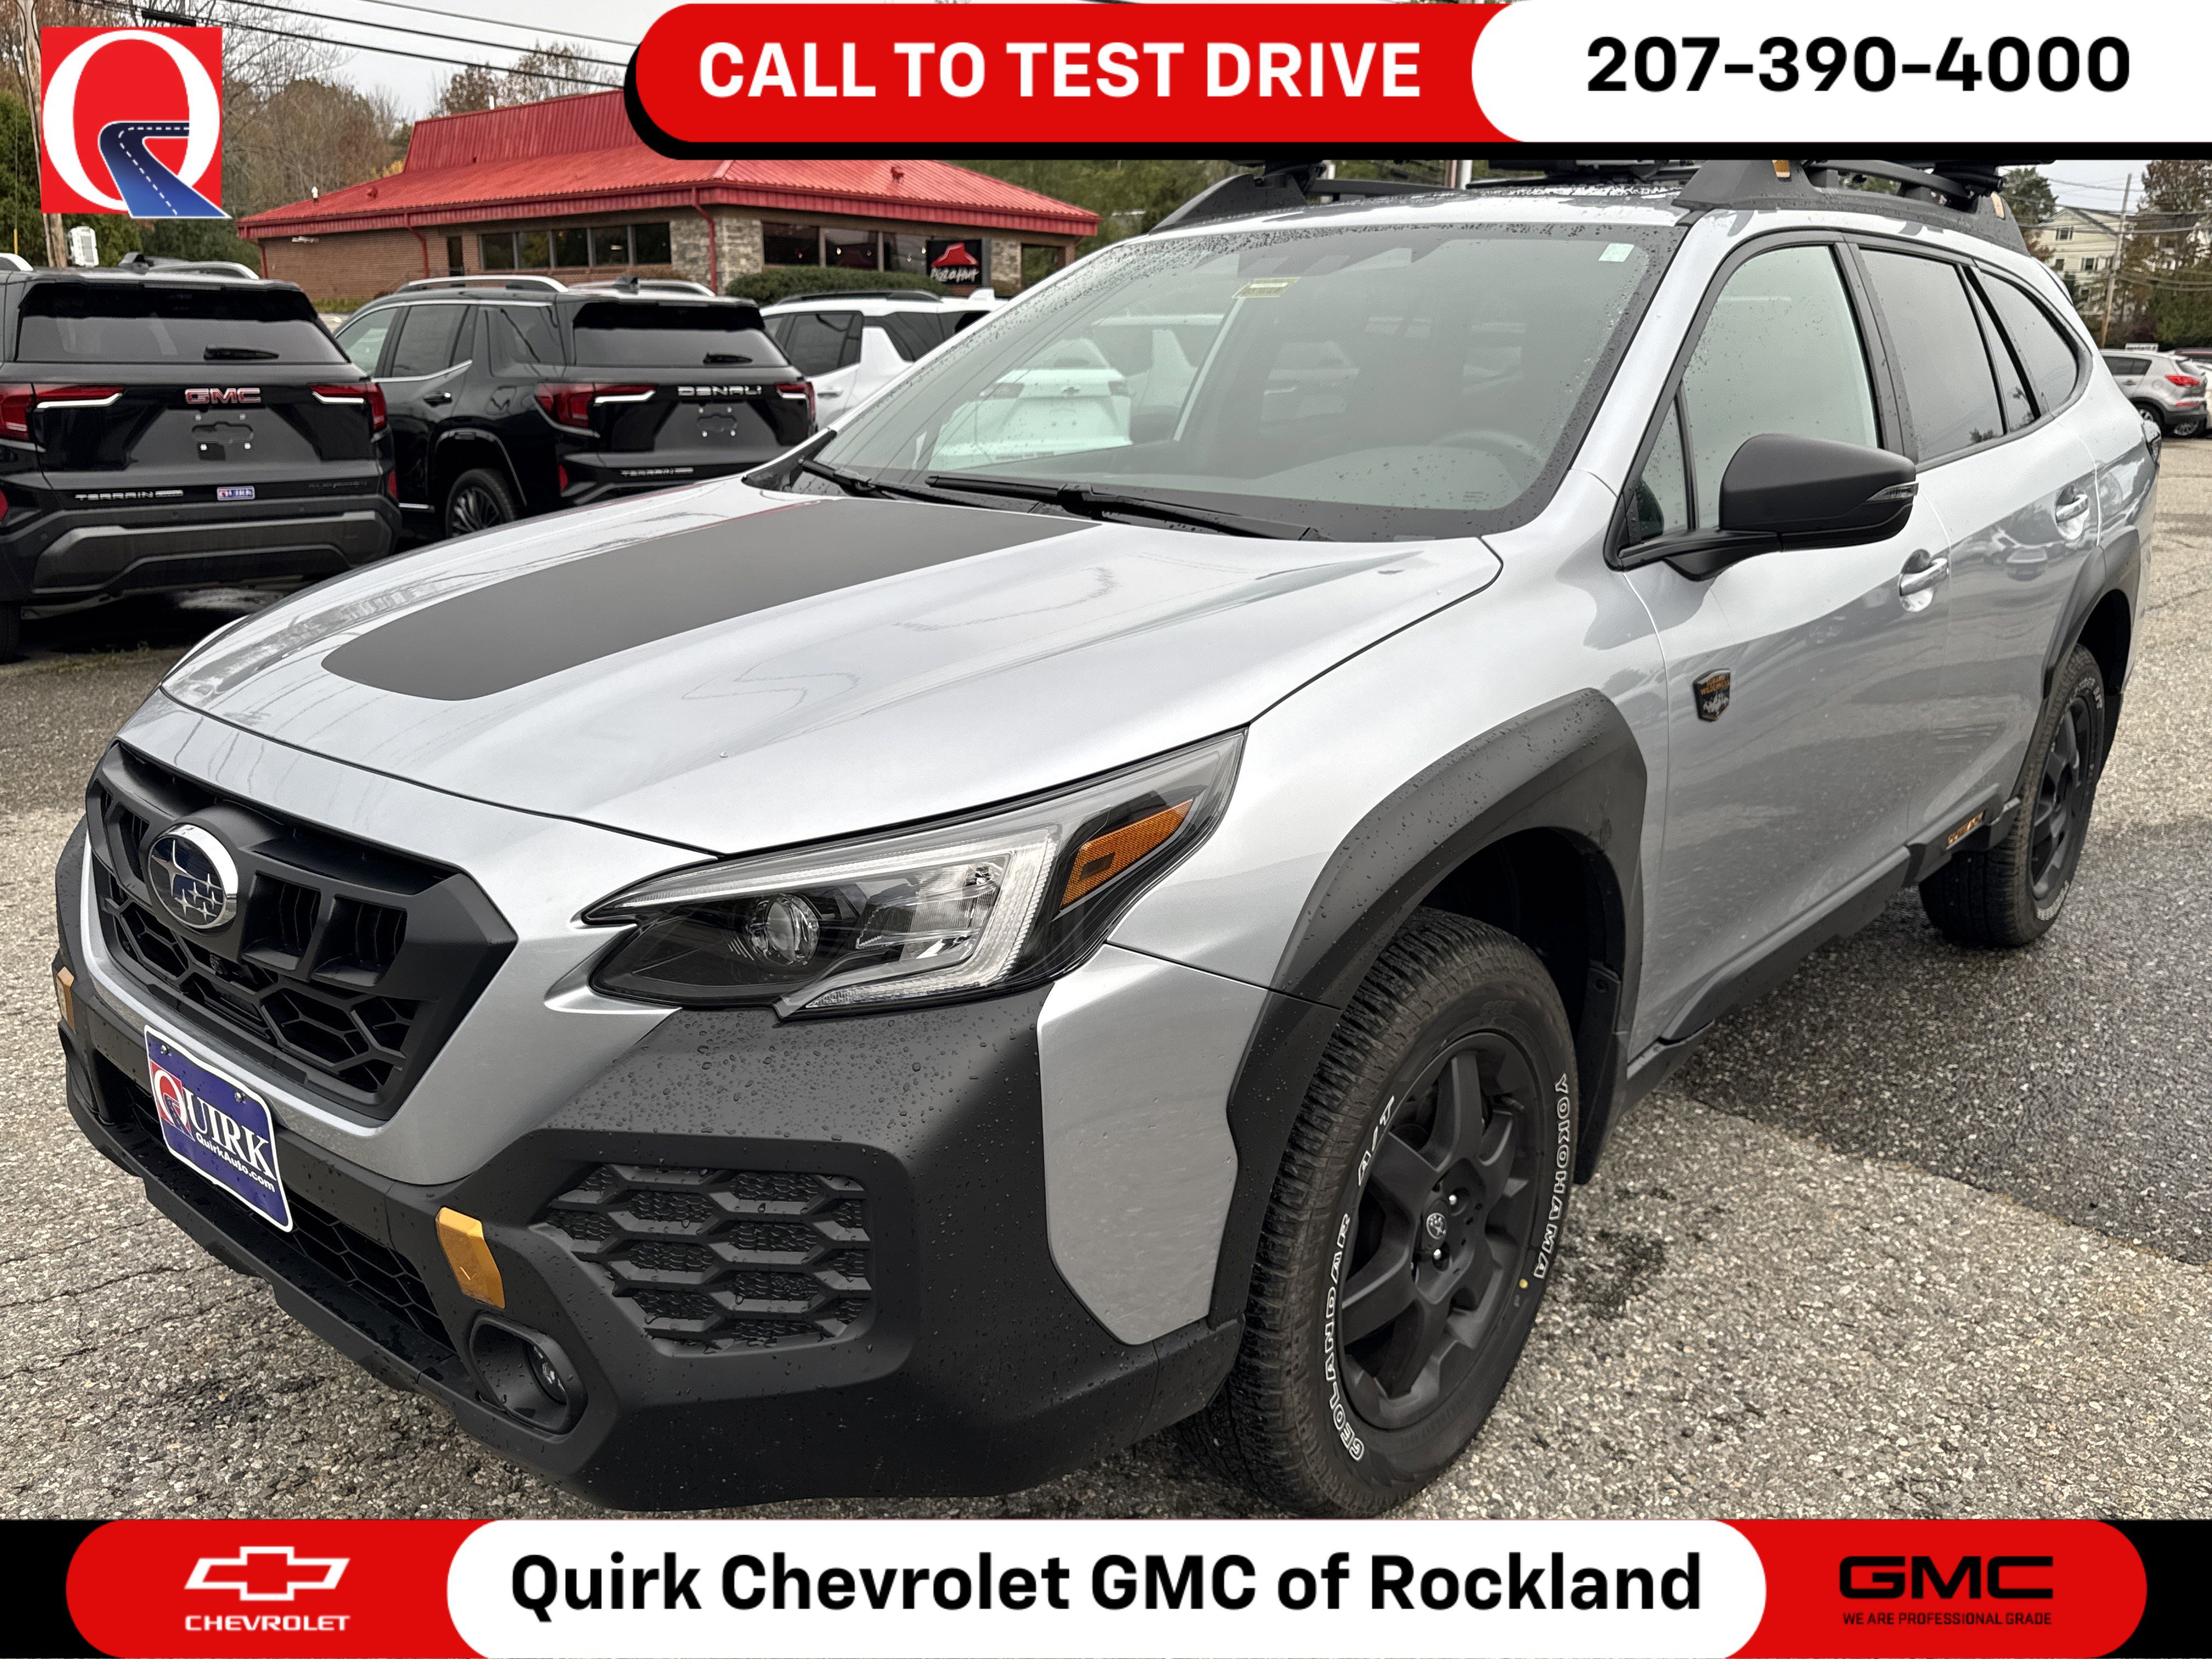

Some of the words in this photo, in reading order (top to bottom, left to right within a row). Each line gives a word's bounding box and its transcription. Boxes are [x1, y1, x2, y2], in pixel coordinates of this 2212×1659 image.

[185, 387, 261, 404] GMC
[678, 386, 761, 396] DENALI
[75, 492, 154, 500] TERRAIN
[153, 1070, 277, 1181] QUIRK
[195, 1132, 275, 1193] QuirkAuto.com
[1533, 1073, 1571, 1279] YOKOHAMA
[1323, 1213, 1365, 1462] GEOLANDAR
